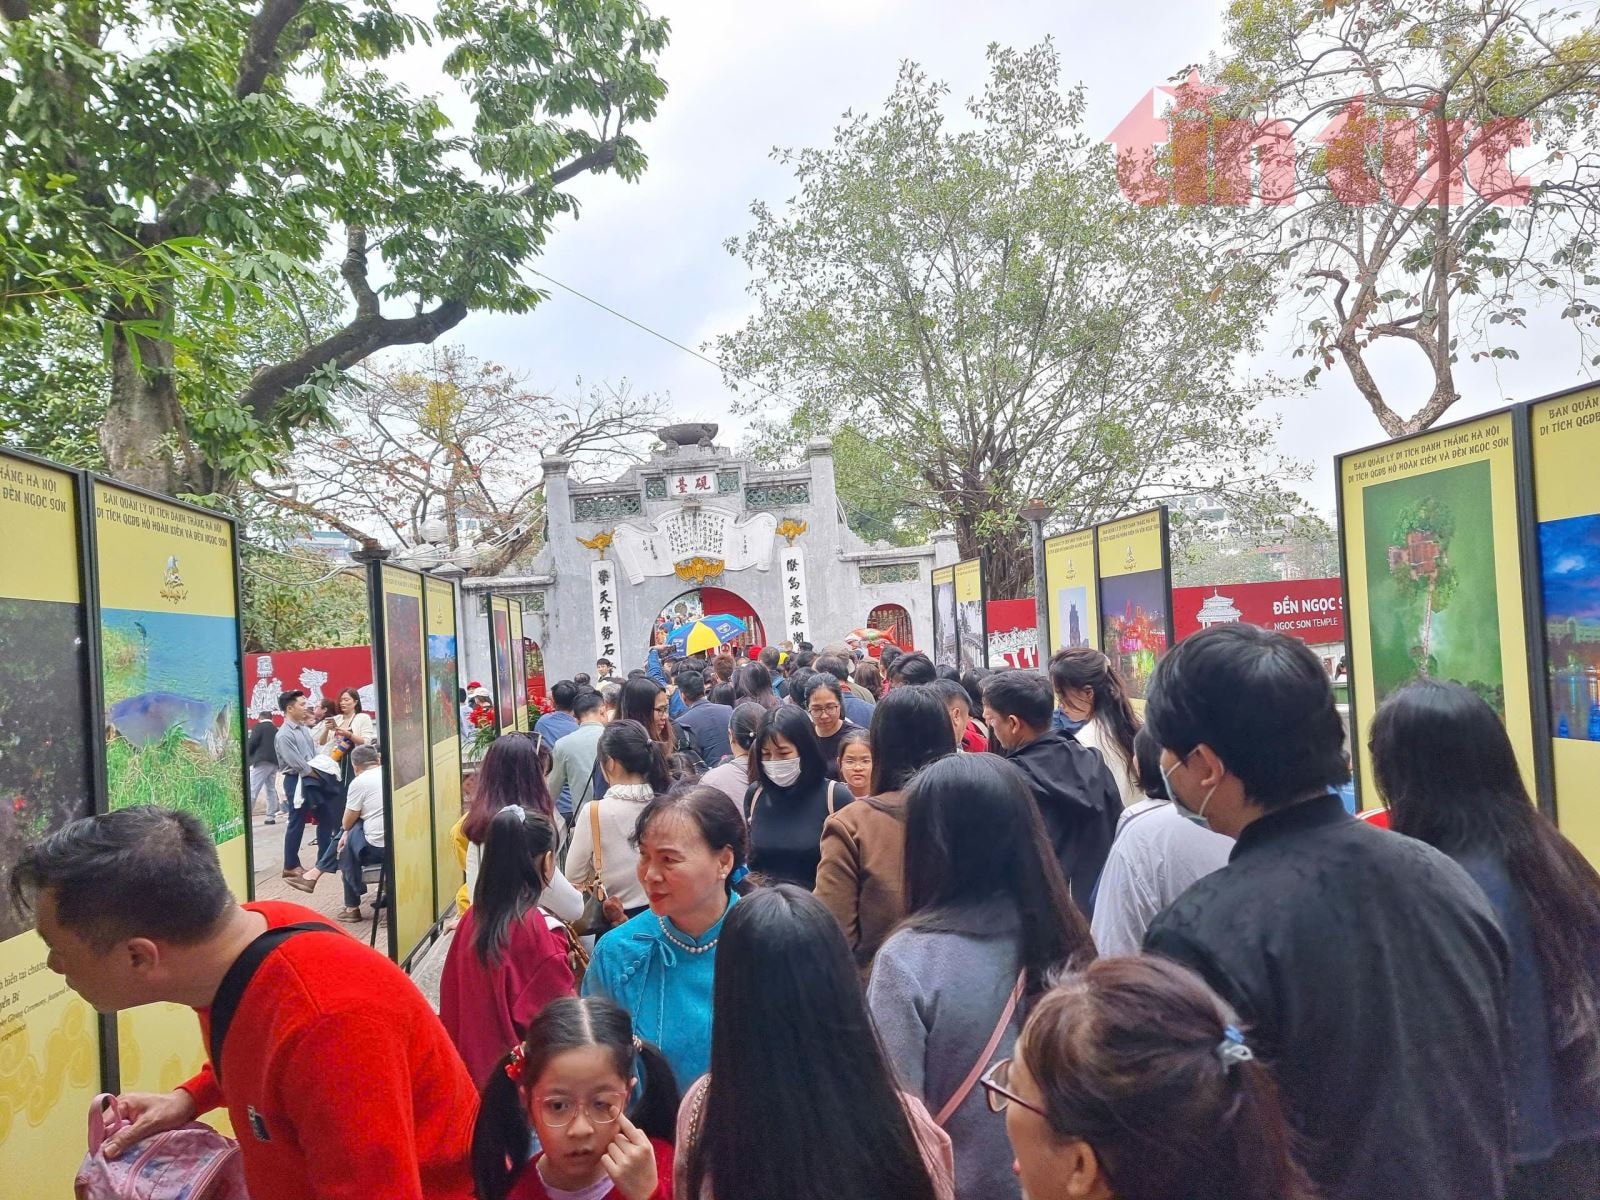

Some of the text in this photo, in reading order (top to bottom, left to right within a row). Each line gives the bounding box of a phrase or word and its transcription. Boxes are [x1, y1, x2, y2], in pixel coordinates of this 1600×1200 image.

[1549, 396, 1599, 419] BAN QUẢN
[1540, 425, 1549, 436] DI
[1552, 419, 1573, 433] TÍCH
[1348, 475, 1355, 484] DI
[1355, 471, 1369, 482] TÍCH
[1398, 458, 1418, 471] HOÀN
[1419, 454, 1438, 466] KIẾM
[1439, 450, 1451, 462] VÀ
[1452, 445, 1467, 459] ĐỀN
[1469, 441, 1490, 456] NGỌC
[1492, 436, 1509, 450] SƠN
[1353, 461, 1367, 471] BAN
[1367, 454, 1385, 467] QUẢN
[1395, 451, 1403, 460] DI
[1403, 446, 1420, 459] TÍCH
[1421, 441, 1441, 455] DANH
[1443, 434, 1469, 449] THẮNG
[1471, 429, 1484, 441] HÀ
[1485, 425, 1500, 438] NỘI
[3, 484, 67, 513] ĐỀN NGỌC SƠN
[103, 492, 118, 505] BAN
[120, 496, 138, 511] QUẢN
[149, 505, 155, 515] DI
[157, 506, 170, 519] TÍCH
[96, 507, 104, 519] DI
[106, 508, 121, 523] TÍCH
[184, 528, 193, 540] VÀ
[1273, 595, 1299, 615] ĐỀN
[1301, 597, 1336, 615] NGỌC
[1274, 617, 1339, 630] NGOC SON TEMPLE
